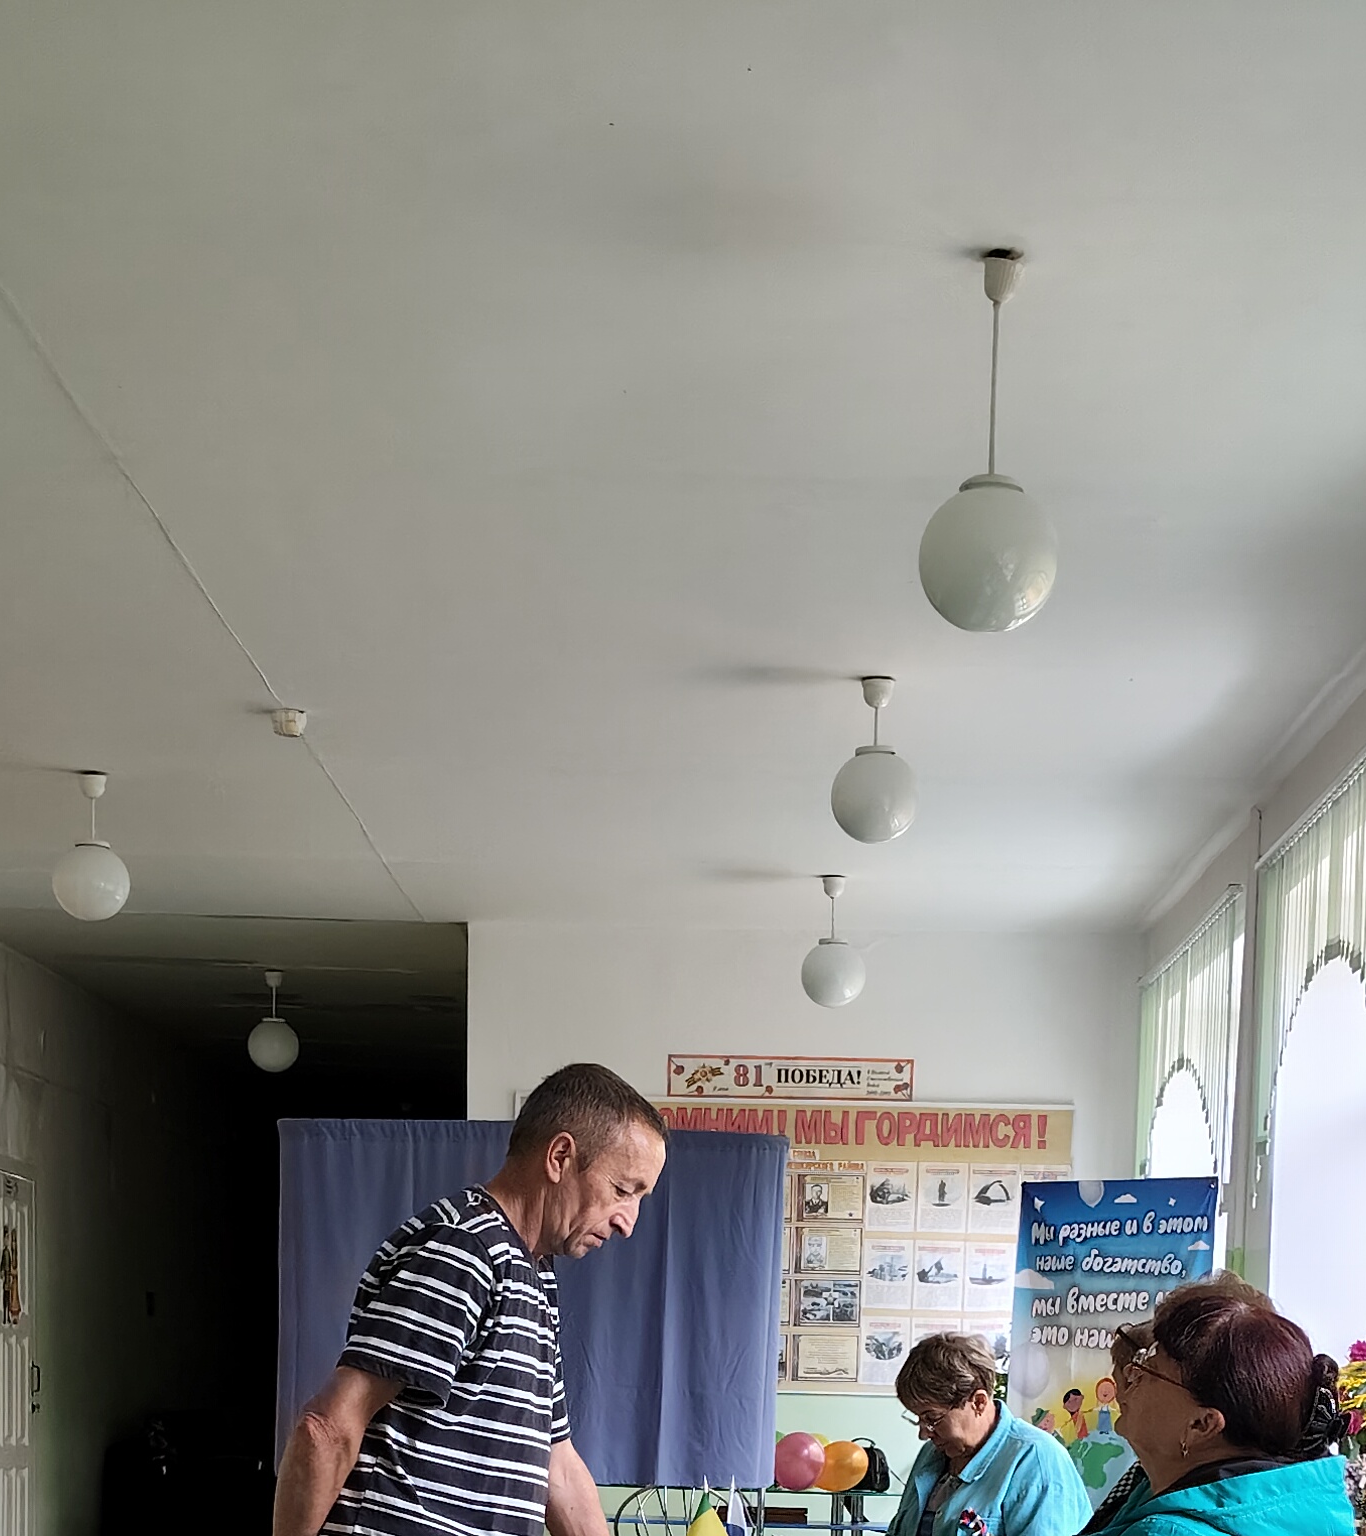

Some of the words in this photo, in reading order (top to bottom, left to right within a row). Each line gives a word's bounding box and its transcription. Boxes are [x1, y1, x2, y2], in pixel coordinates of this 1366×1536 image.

[734, 1064, 764, 1087] 81
[776, 1067, 862, 1088] ПОБЕДА!
[659, 1107, 787, 1136] ОМНИМ!
[795, 1109, 849, 1146] МЫ
[855, 1110, 1048, 1150] ГОРДИМСЯ!
[1031, 1222, 1054, 1246] Мы
[1058, 1219, 1121, 1247] разные
[1125, 1219, 1139, 1235] и
[1142, 1211, 1155, 1234] в
[1158, 1216, 1208, 1234] этом
[1036, 1254, 1075, 1272] наше
[1081, 1248, 1187, 1278] богатство,
[1031, 1297, 1061, 1318] мы
[1066, 1286, 1150, 1315] вместе
[1030, 1325, 1069, 1345] это
